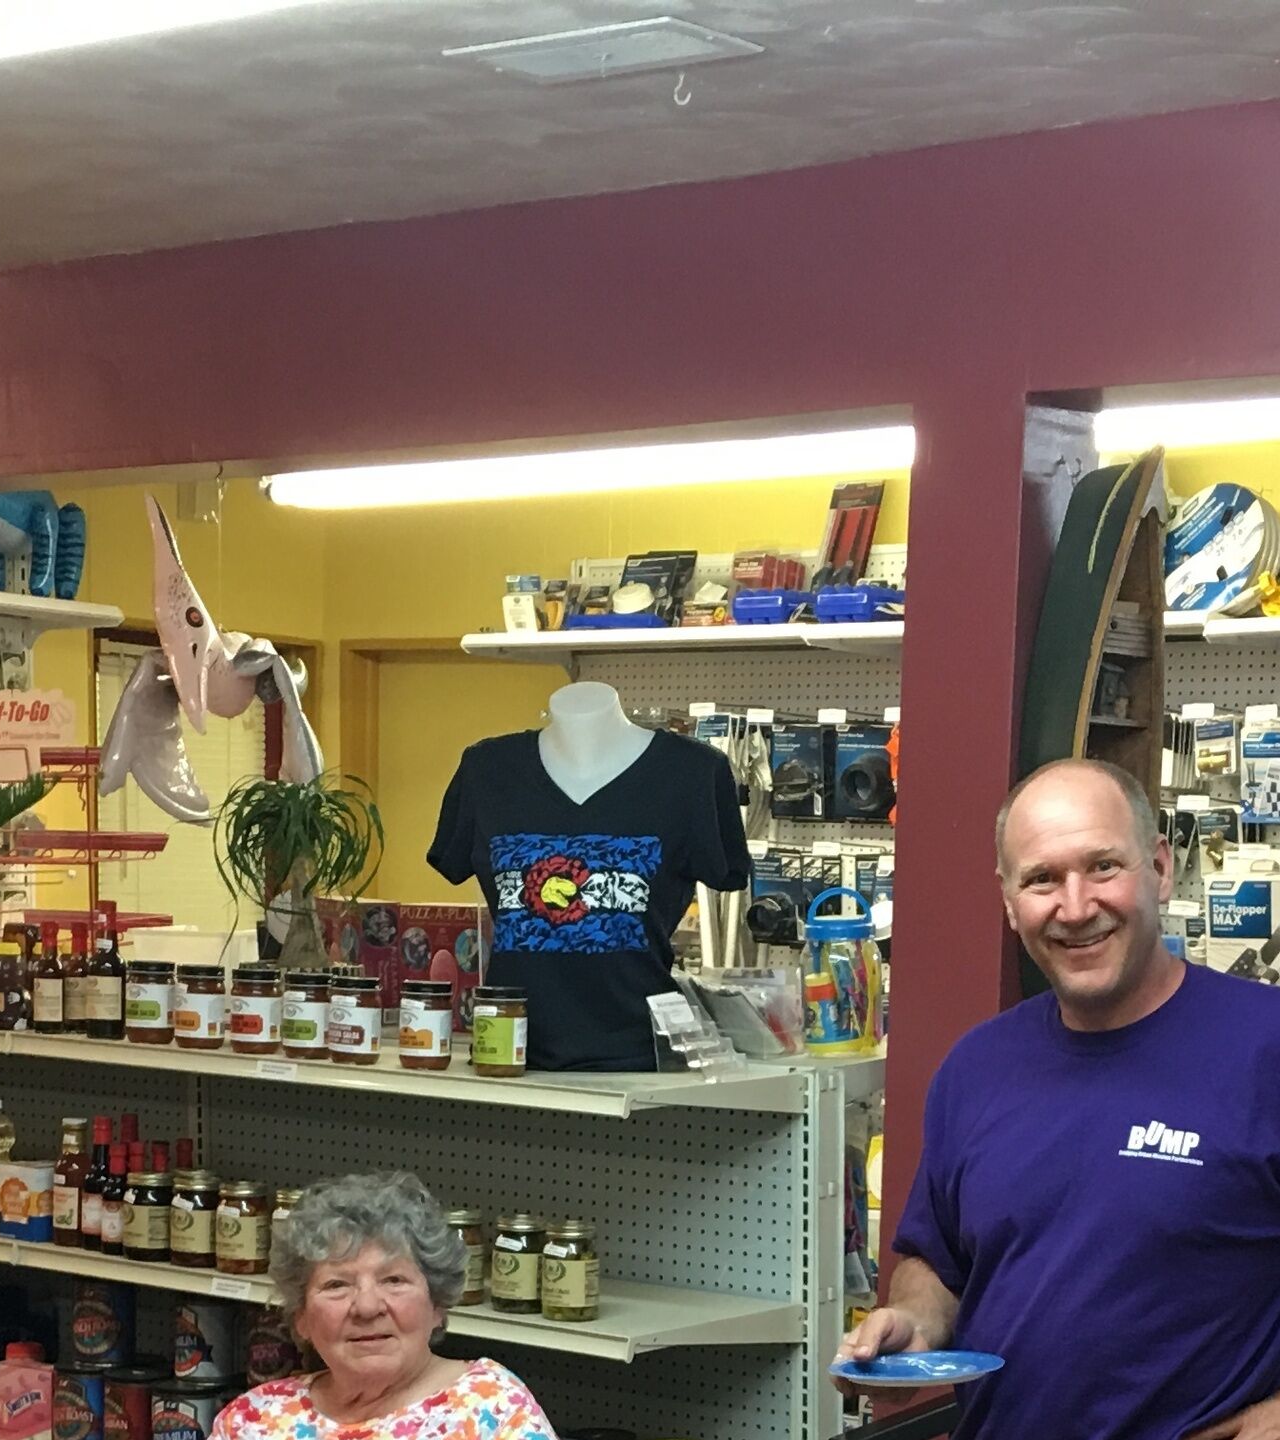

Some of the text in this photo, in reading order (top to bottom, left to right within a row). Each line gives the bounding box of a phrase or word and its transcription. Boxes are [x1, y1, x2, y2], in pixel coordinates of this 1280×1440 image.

[1212, 903, 1267, 917] De-Flapper
[1212, 913, 1242, 927] MAX
[1127, 1120, 1200, 1157] BUMP
